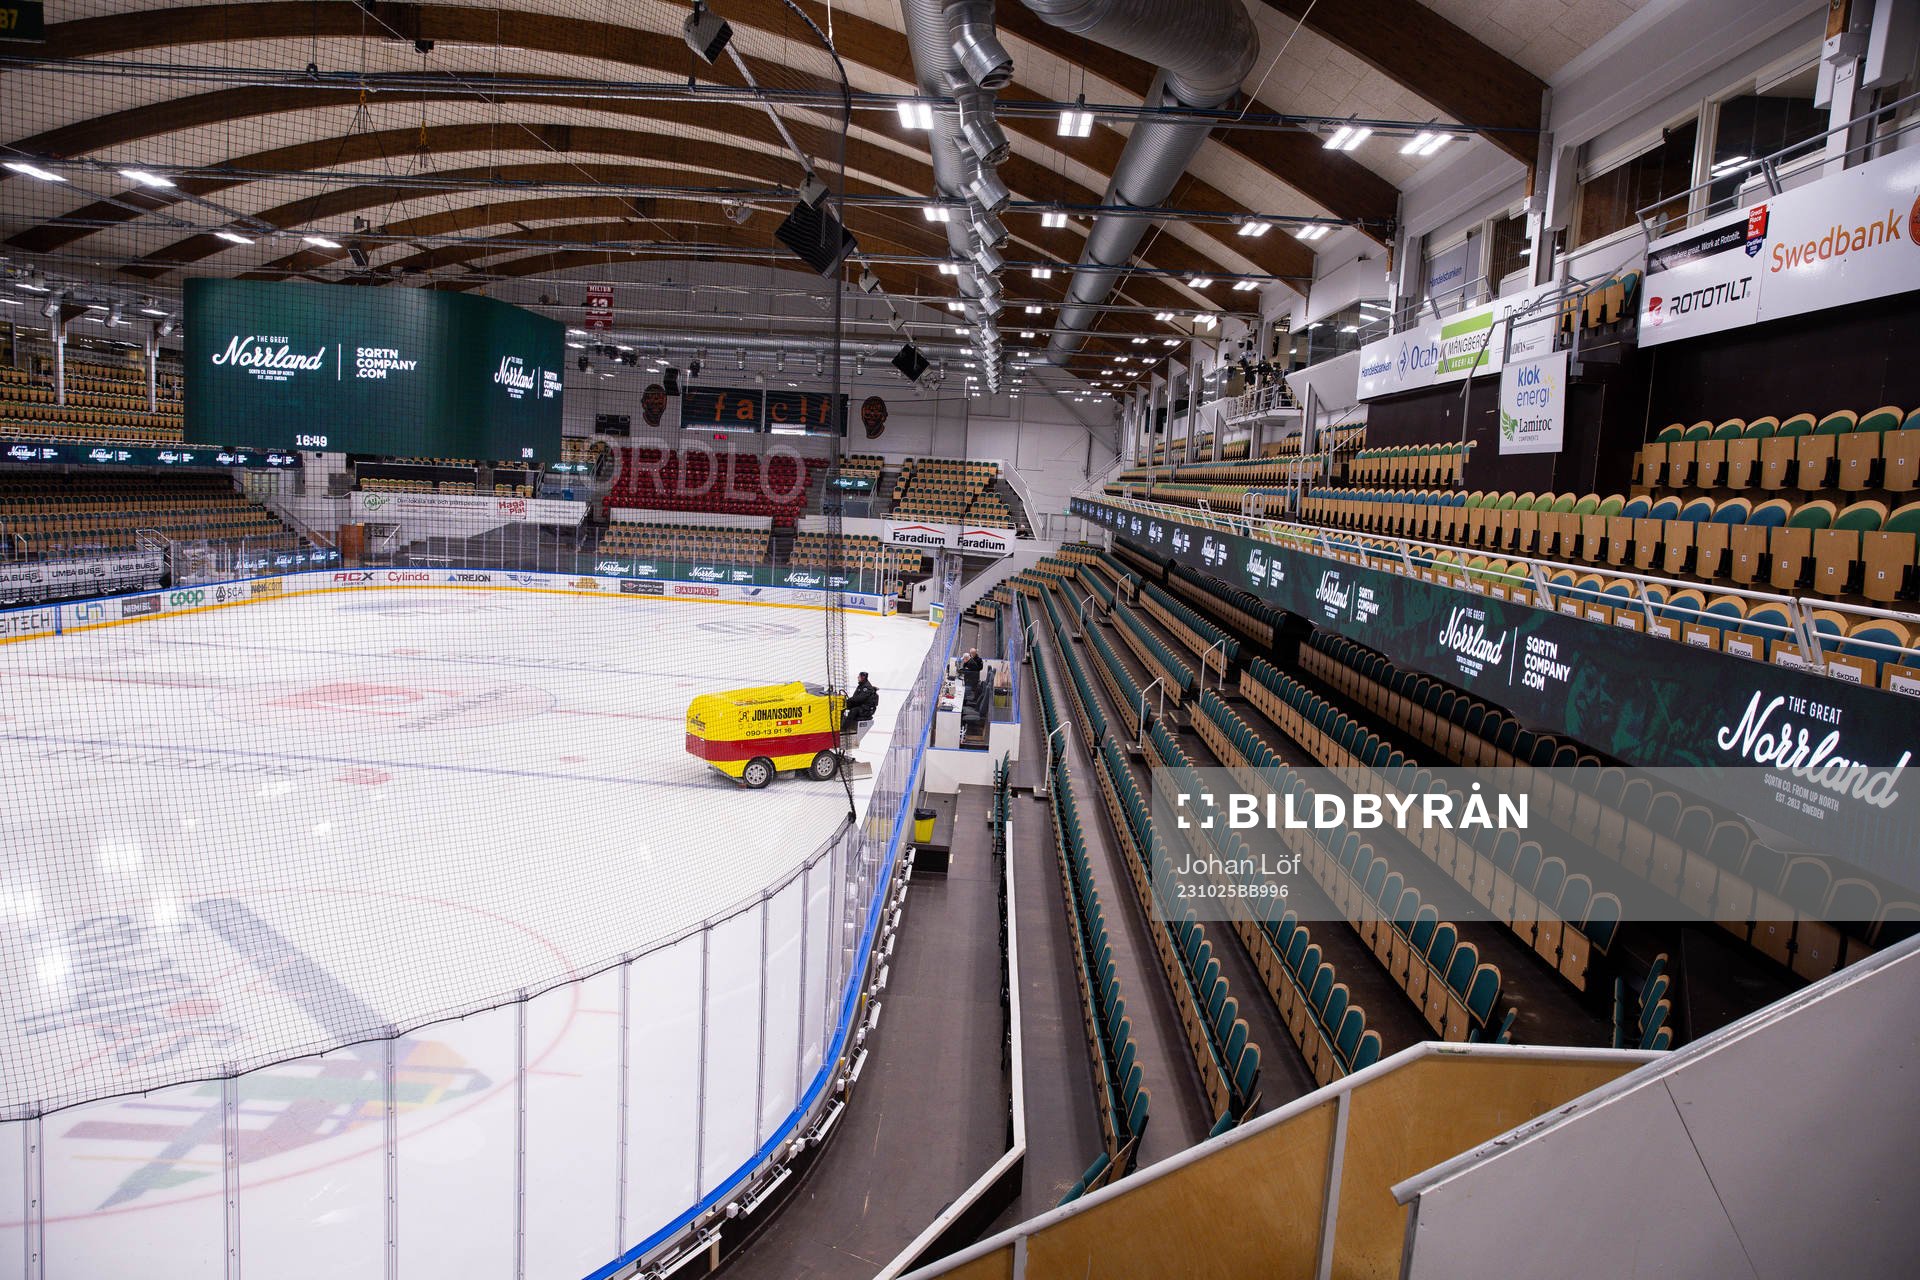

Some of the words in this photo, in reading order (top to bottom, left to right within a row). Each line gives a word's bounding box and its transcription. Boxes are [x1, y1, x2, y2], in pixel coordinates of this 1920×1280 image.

[1701, 239, 1714, 250] Work
[1714, 238, 1720, 246] at
[1771, 208, 1904, 273] Swedbank
[1430, 266, 1462, 287] Handelsbanken
[1670, 276, 1752, 316] ROTOTILT
[256, 335, 268, 343] THE
[270, 336, 289, 344] GREAT
[212, 335, 326, 371] Norrland
[356, 347, 399, 359] SQRTN
[1411, 342, 1438, 370] Ocab
[356, 358, 417, 371] COMPANY
[494, 355, 535, 389] Norrland
[1361, 361, 1392, 378] Handelsbanken
[356, 368, 387, 379] .COM
[1517, 365, 1540, 387] klok
[1517, 387, 1550, 408] energi
[1519, 415, 1552, 433] Lamiroc
[296, 434, 328, 447] 16:49
[499, 500, 525, 509] Haga
[893, 531, 945, 545] Faradium
[957, 537, 1006, 550] Faradium
[388, 571, 430, 582] Cylinda
[456, 574, 491, 582] TREJON
[784, 572, 820, 584] Norrland
[169, 589, 205, 606] coop
[227, 586, 243, 598] SCA
[675, 586, 719, 597] BAUHAUS
[1465, 607, 1473, 619] THE
[1473, 609, 1485, 621] GREAT
[1439, 606, 1507, 665] Norrland
[1526, 635, 1558, 660] SQRTN
[1524, 653, 1571, 682] COMPANY
[1521, 672, 1545, 691] .COM
[751, 705, 803, 722] JOHANSSONS
[1788, 695, 1806, 715] THE
[1809, 701, 1843, 725] GREAT
[1717, 690, 1912, 809] Norrland
[1782, 780, 1791, 794] CO.
[1792, 784, 1809, 800] FROM
[1809, 790, 1818, 803] UP
[1818, 794, 1840, 812] NORTH
[1802, 802, 1825, 820] SWEDEN
